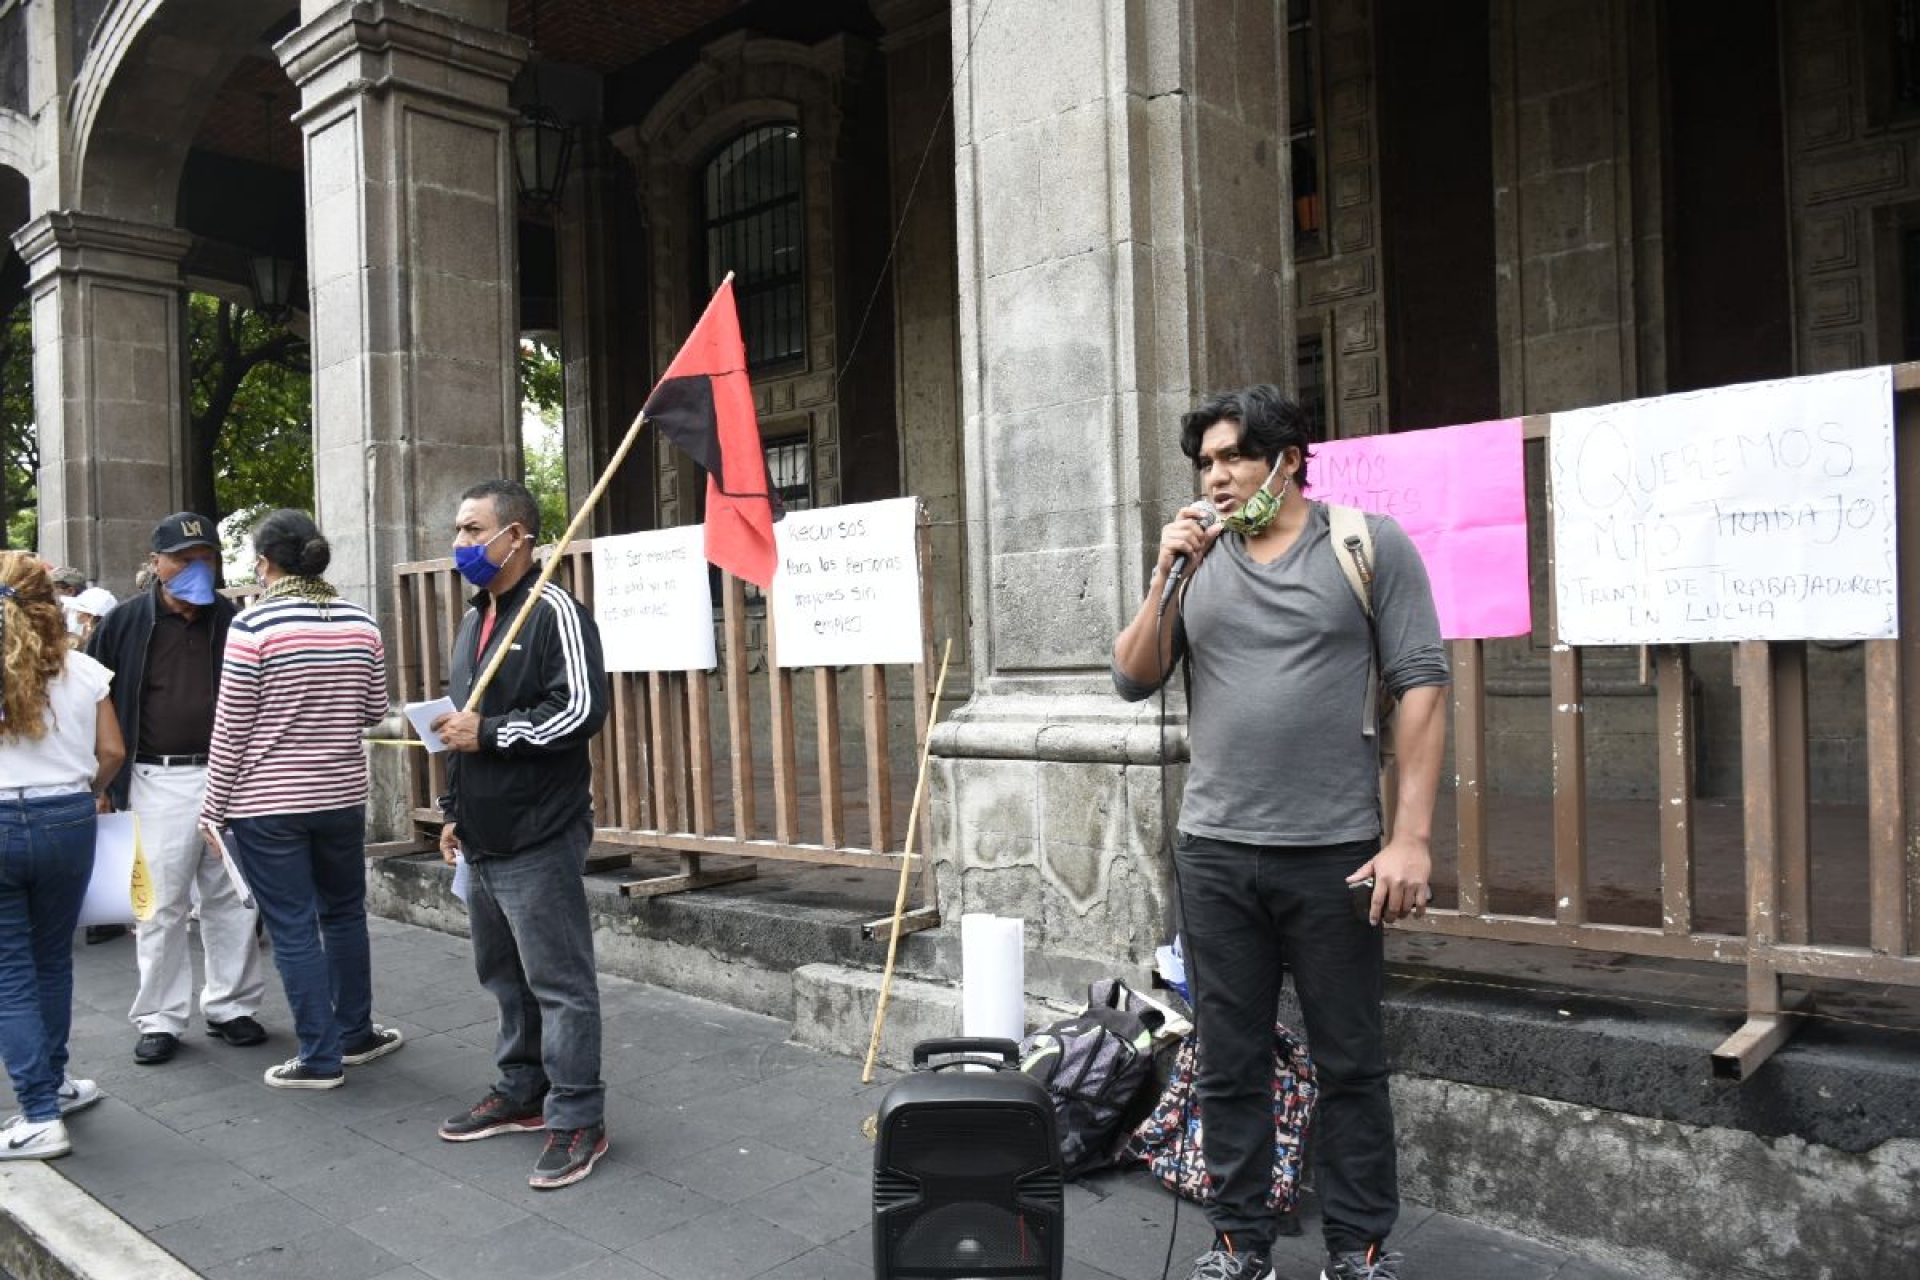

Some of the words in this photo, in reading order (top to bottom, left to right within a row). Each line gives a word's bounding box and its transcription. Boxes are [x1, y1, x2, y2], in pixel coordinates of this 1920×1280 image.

[1318, 453, 1385, 487] IMOS
[1576, 420, 1854, 509] QUEREMOS
[1706, 494, 1876, 545] TRABAJO
[1664, 578, 1699, 597] DE
[1685, 600, 1775, 622] LUCHA
